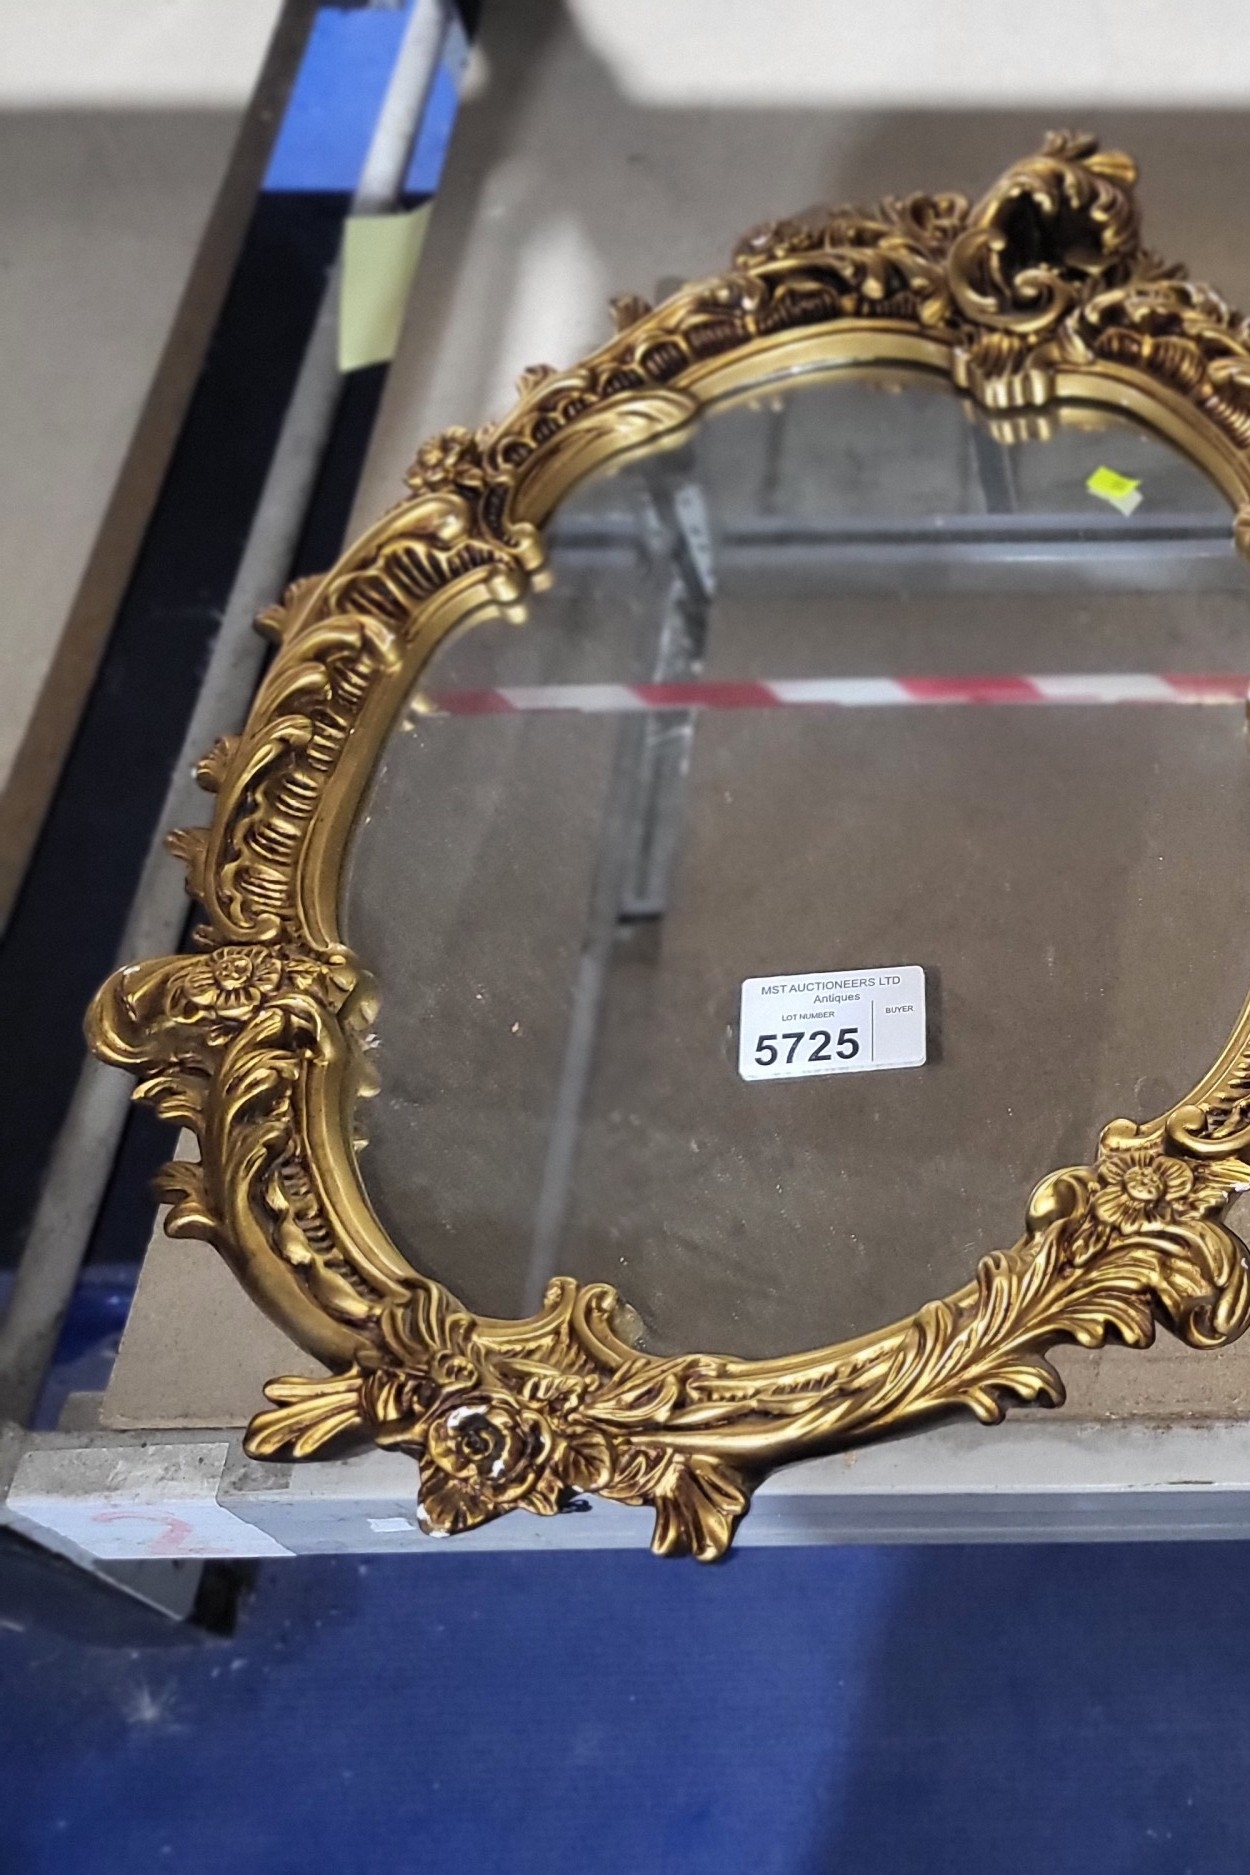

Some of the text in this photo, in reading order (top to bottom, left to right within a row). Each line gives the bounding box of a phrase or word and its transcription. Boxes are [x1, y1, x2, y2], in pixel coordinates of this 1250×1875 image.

[761, 976, 901, 995] MST AUCTIONEERS LTD
[813, 993, 861, 1004] Antiques
[885, 1005, 914, 1014] BUYER
[782, 1011, 835, 1022] LOT NUMBER
[754, 1027, 860, 1066] 5725
